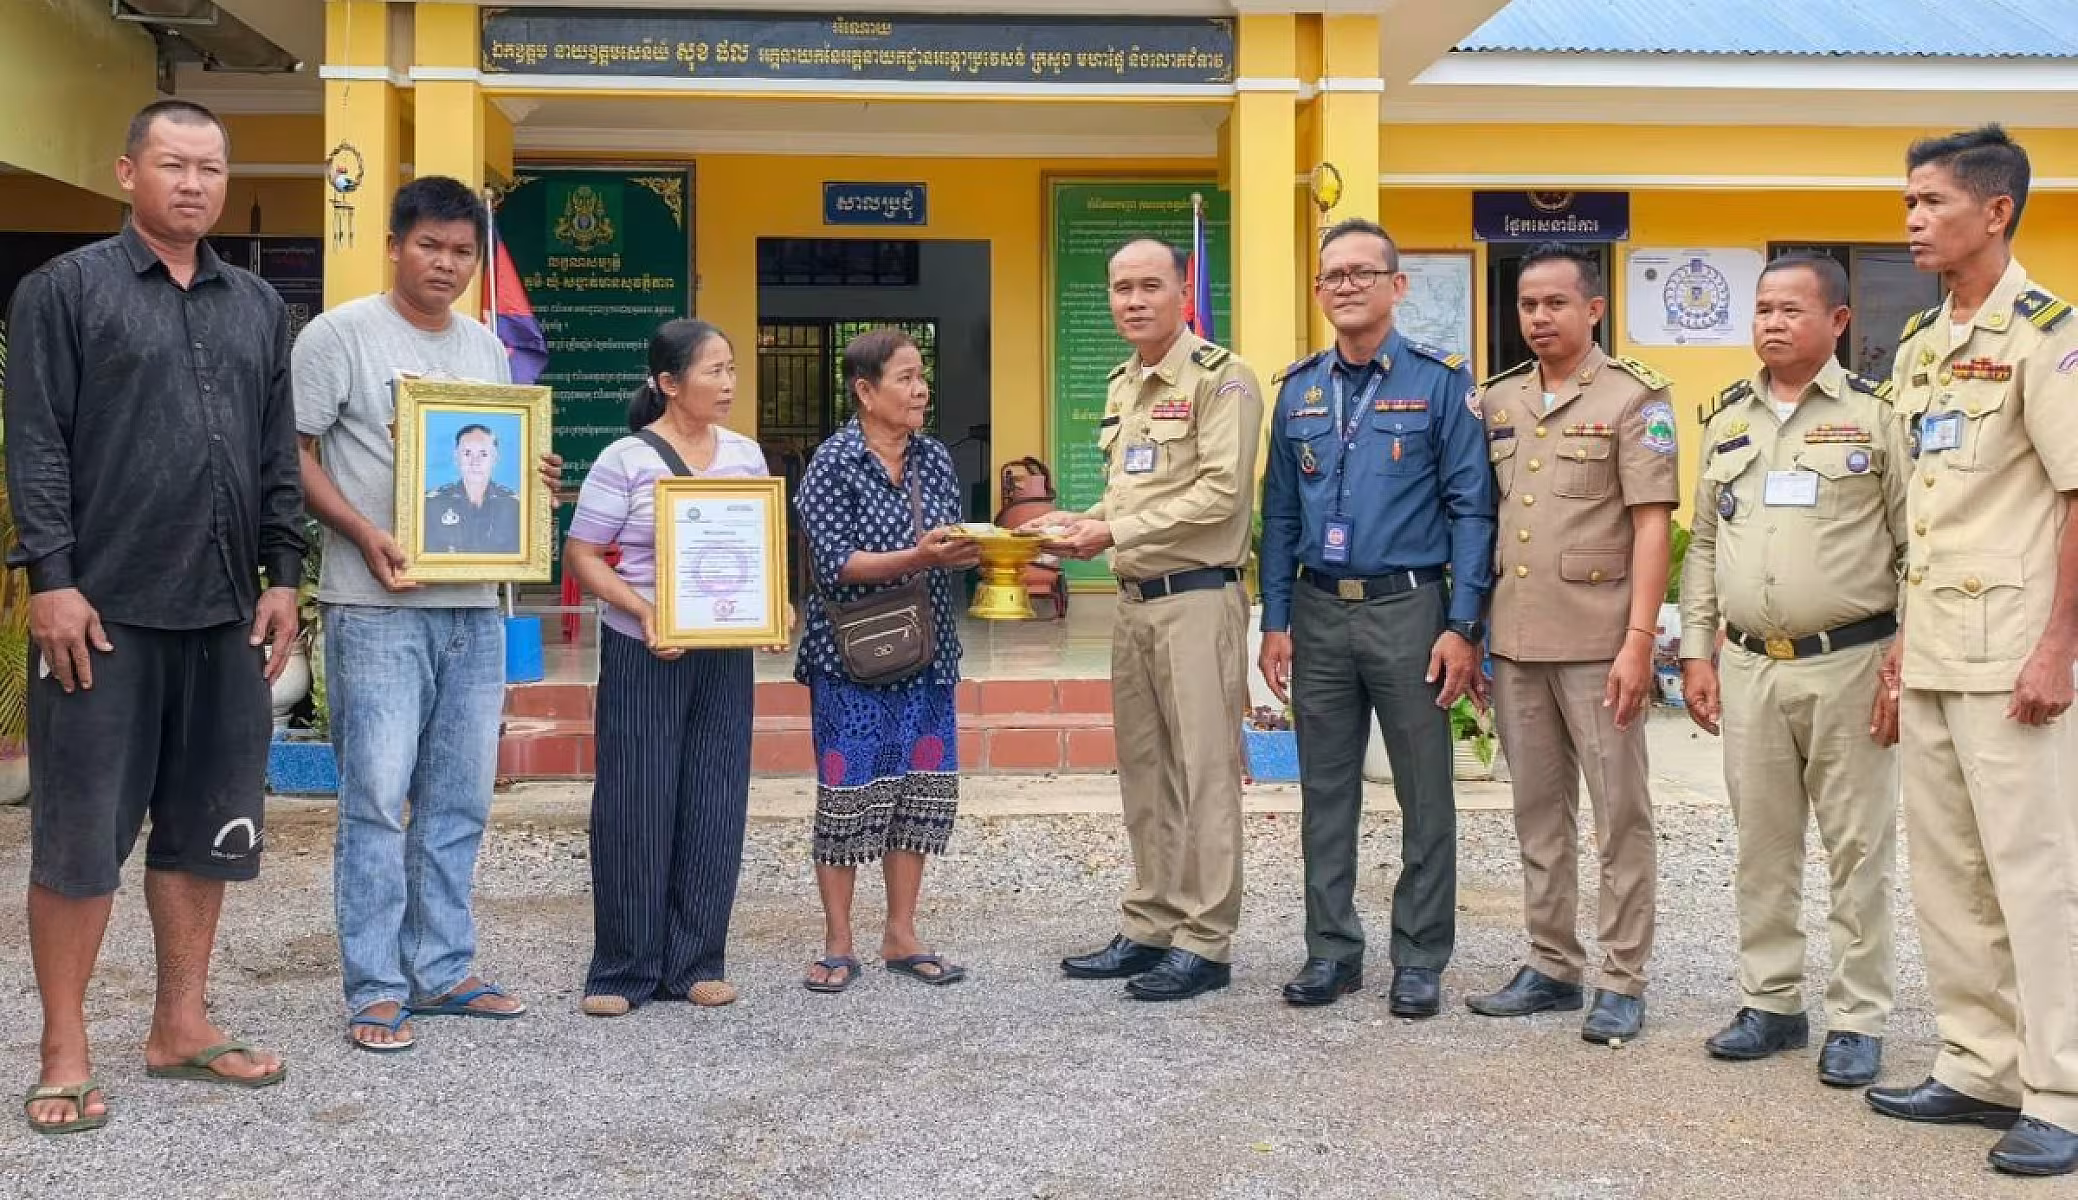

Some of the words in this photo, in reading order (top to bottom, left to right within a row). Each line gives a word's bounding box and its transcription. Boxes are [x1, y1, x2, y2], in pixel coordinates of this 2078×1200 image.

[492, 40, 547, 64] ឯកឧត្តម
[676, 42, 709, 72] សុខ
[835, 188, 914, 219] សាលប្រជុំ
[1504, 214, 1600, 236] ផ្នែកសេនាធិការ
